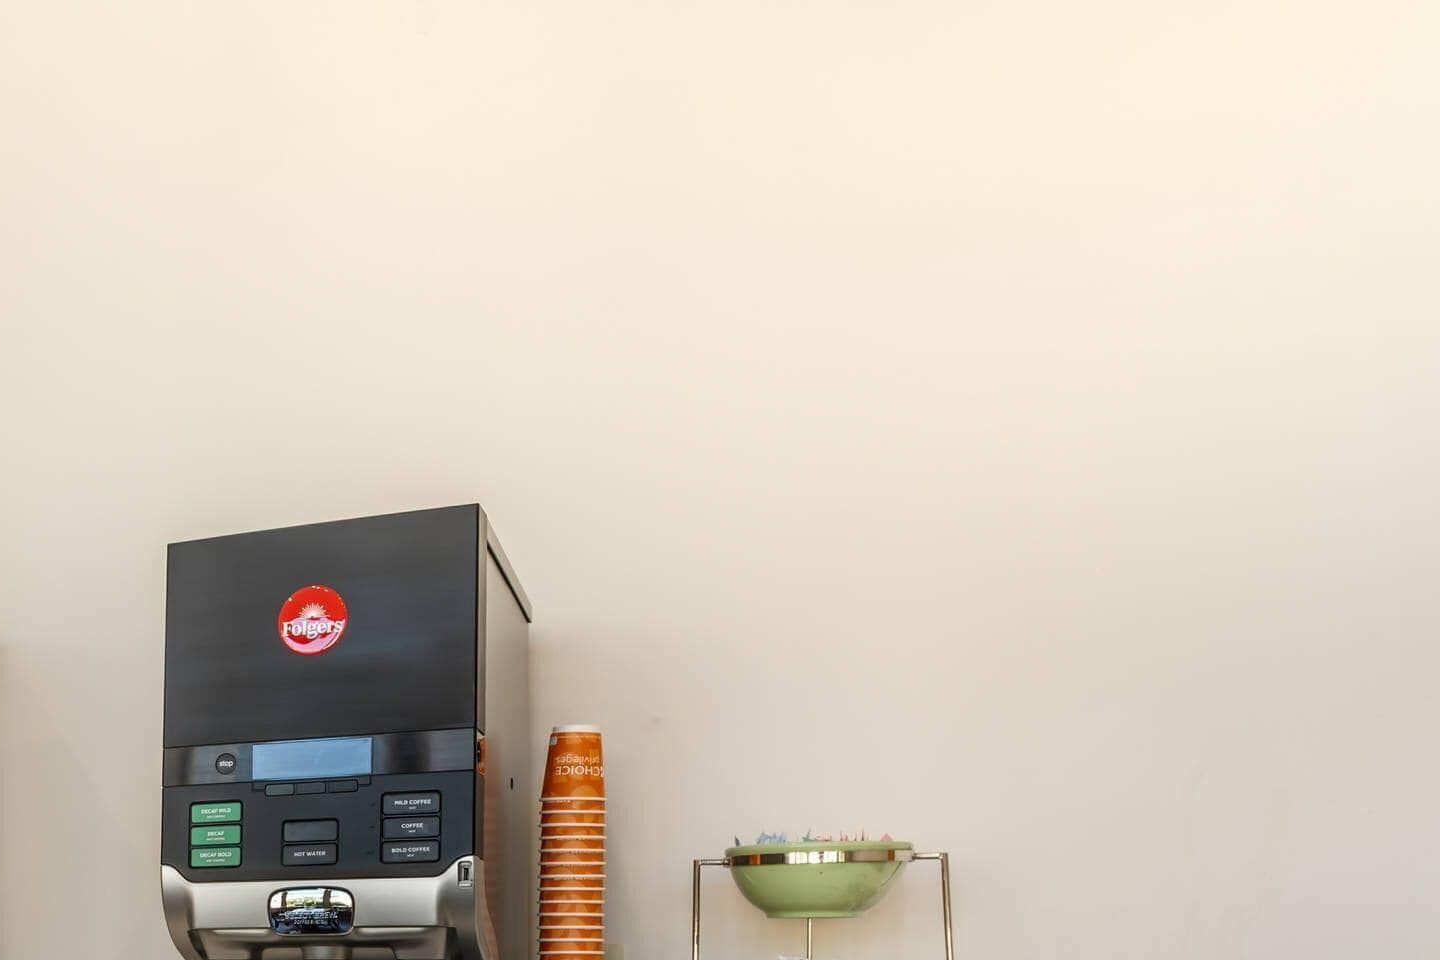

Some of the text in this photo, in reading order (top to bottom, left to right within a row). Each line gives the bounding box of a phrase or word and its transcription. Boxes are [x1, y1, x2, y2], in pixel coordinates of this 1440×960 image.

[282, 620, 344, 639] Folgers
[218, 760, 234, 768] stop
[555, 765, 600, 776] CHOICE
